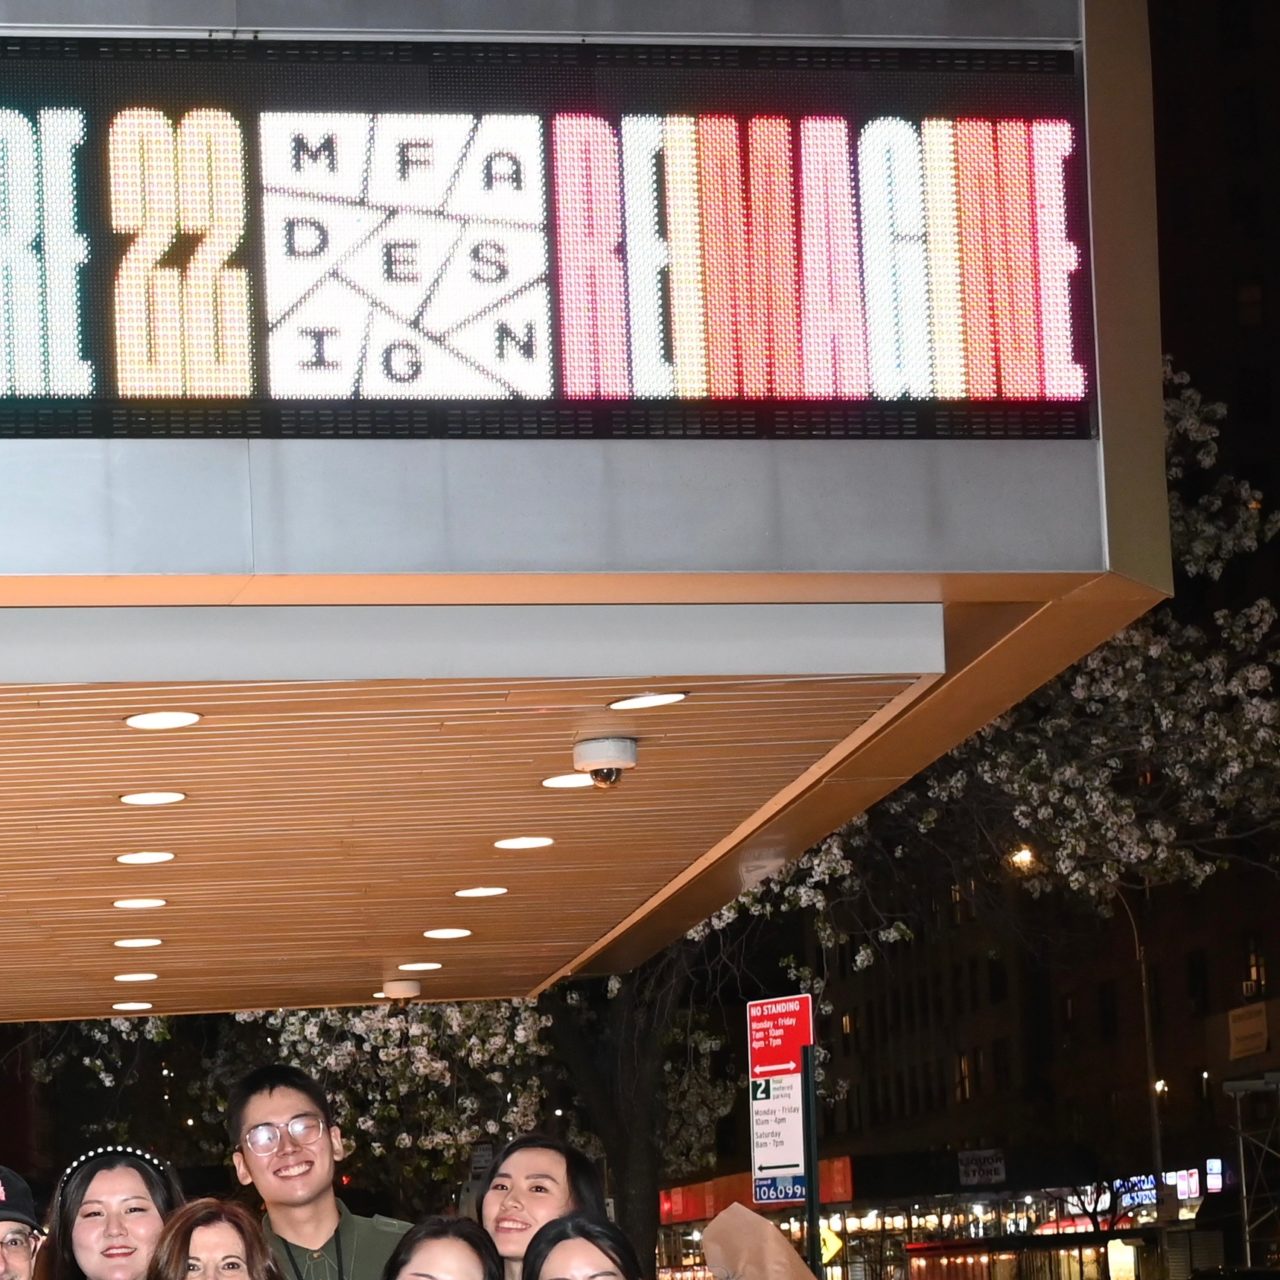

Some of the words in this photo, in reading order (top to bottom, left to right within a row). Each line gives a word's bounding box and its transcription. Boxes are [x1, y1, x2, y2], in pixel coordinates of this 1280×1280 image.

[108, 107, 255, 399] 22
[751, 1006, 762, 1017] NO
[763, 1000, 800, 1015] STANDING
[752, 1020, 774, 1030] Monday
[778, 1017, 797, 1027] Friday
[752, 1031, 765, 1040] 7am
[769, 1028, 784, 1037] 10am
[752, 1040, 765, 1050] 4pm
[769, 1038, 782, 1047] 7pm
[756, 1079, 766, 1099] 2
[755, 1108, 777, 1117] Monday
[781, 1105, 800, 1114] Friday
[774, 1116, 787, 1125] 4pm
[755, 1130, 781, 1139] Saturday
[772, 1138, 785, 1147] 7pm
